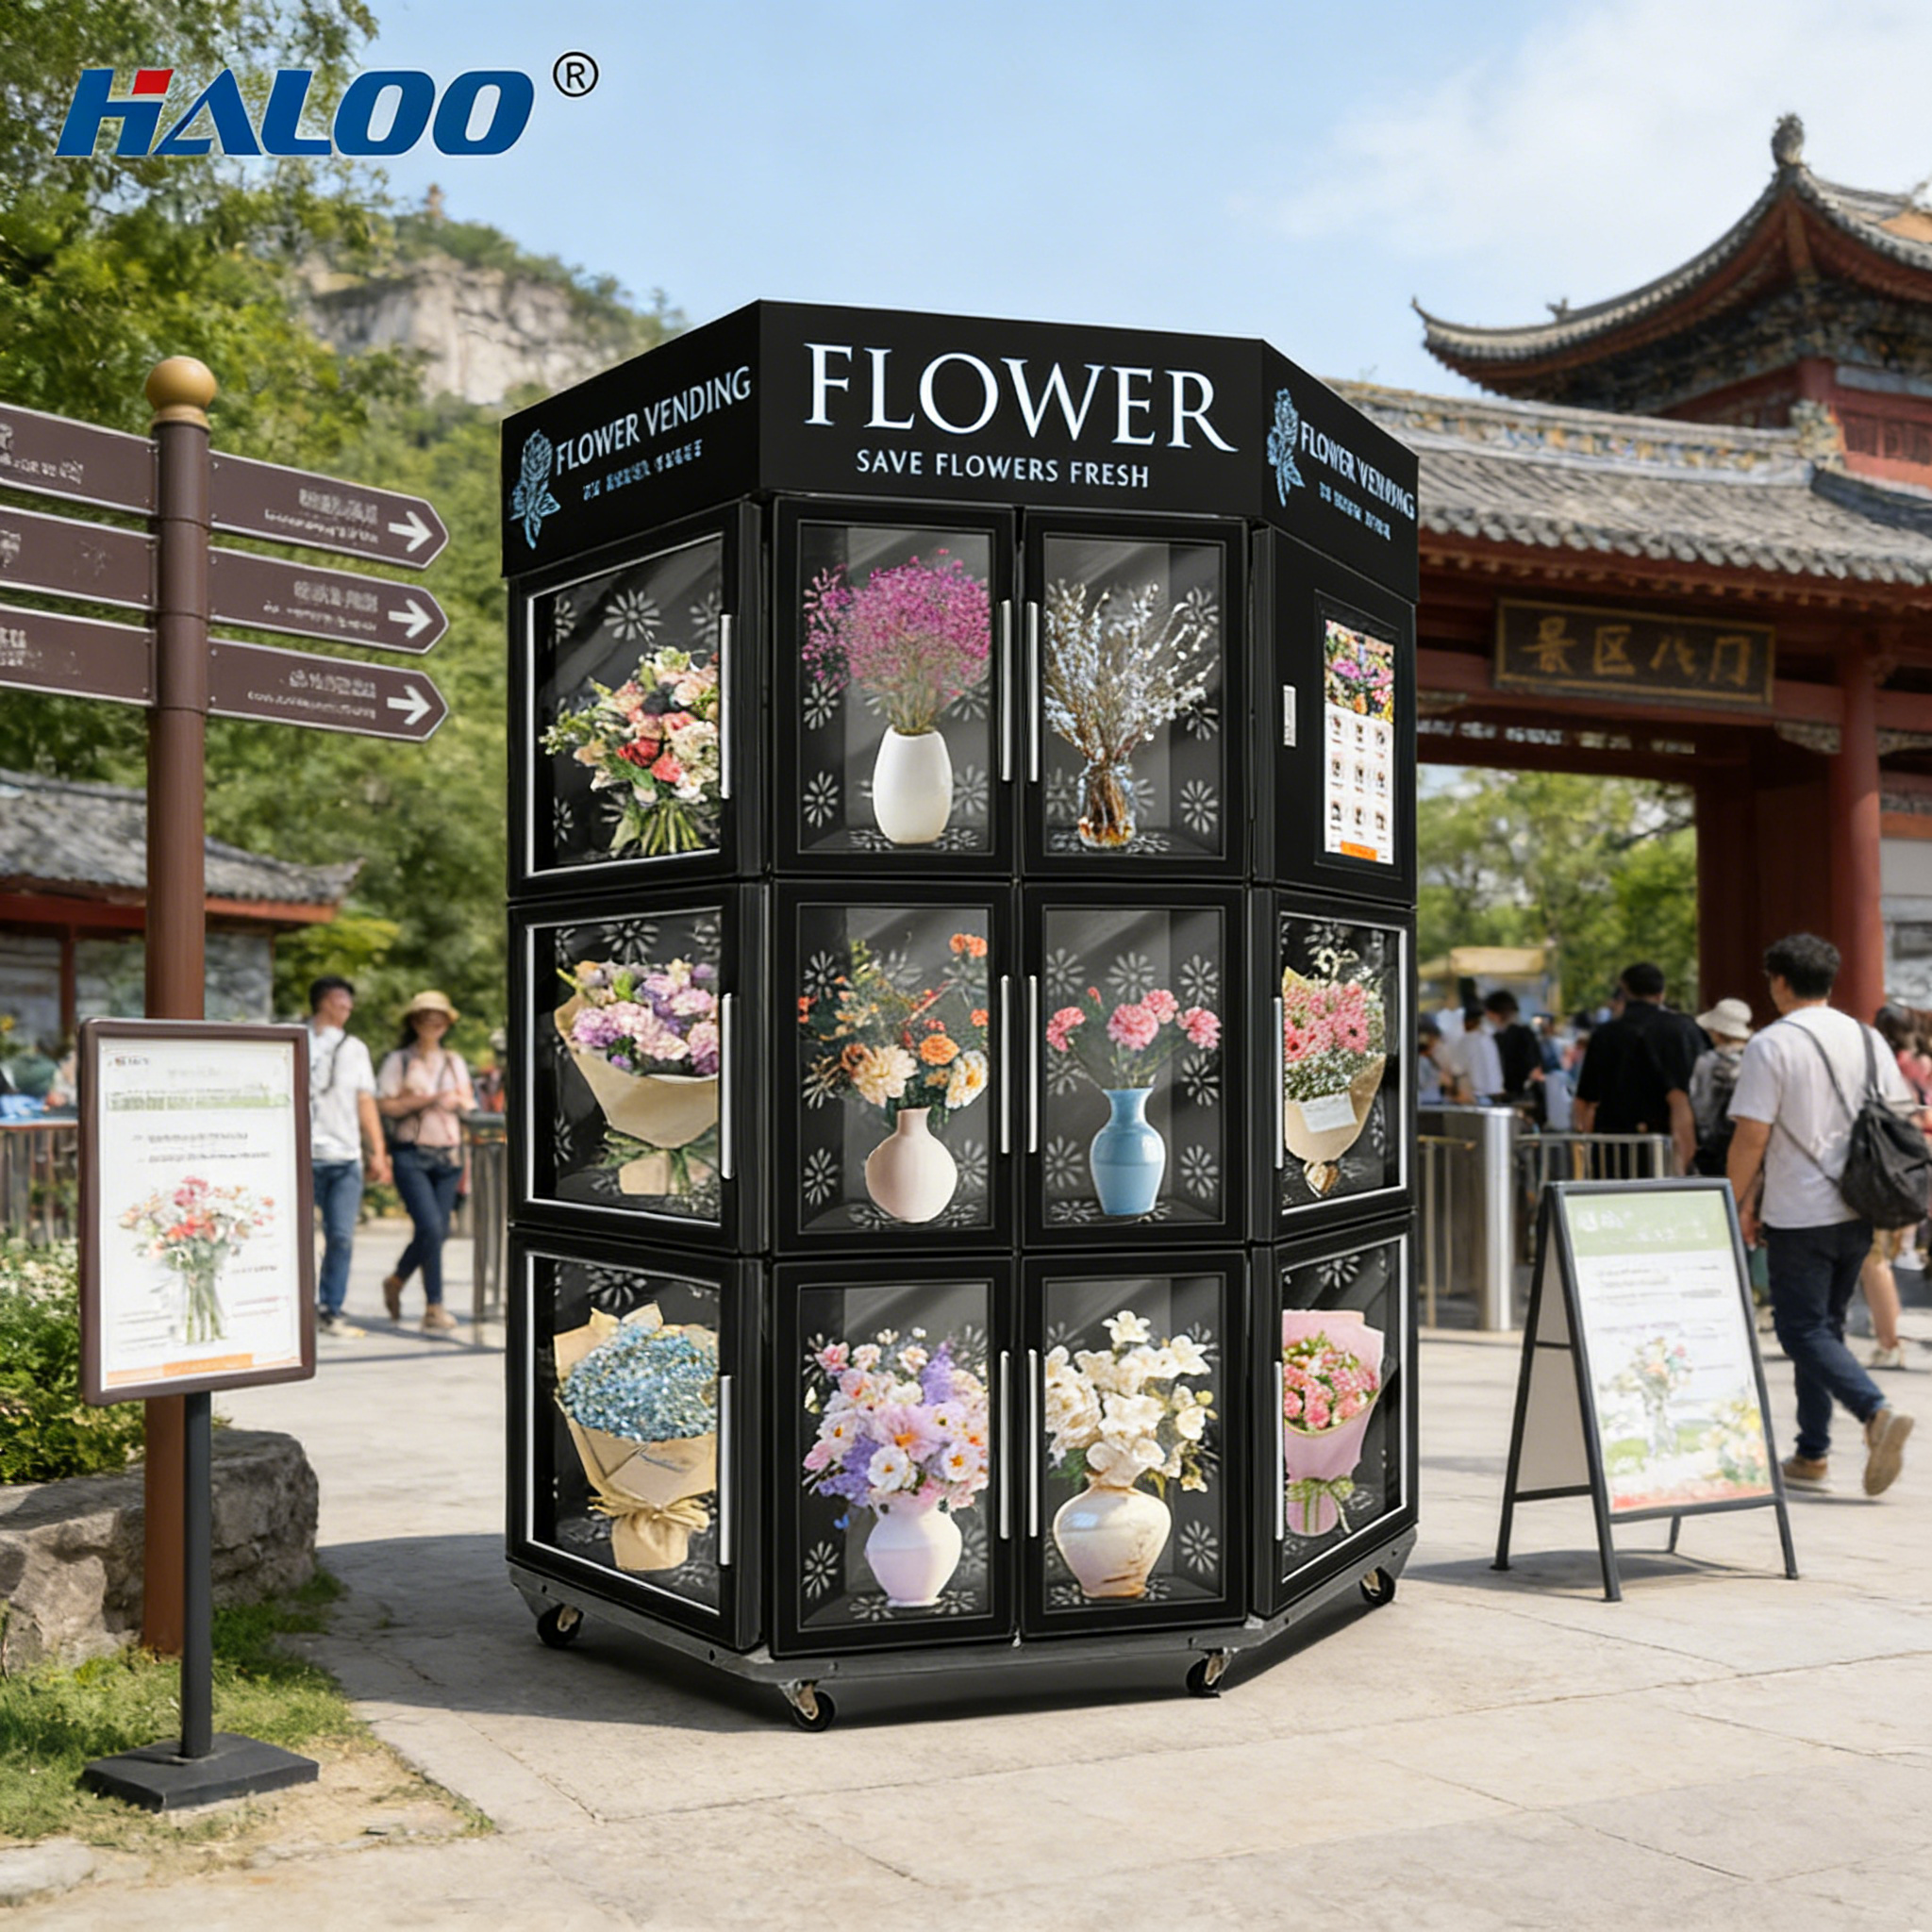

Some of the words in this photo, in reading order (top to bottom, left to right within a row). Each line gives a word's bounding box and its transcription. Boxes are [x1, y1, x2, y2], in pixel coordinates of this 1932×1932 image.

[556, 413, 641, 476] FLOWER
[644, 365, 751, 437] VENDING
[804, 342, 1240, 452] FLOWER
[857, 449, 924, 475] SAVE
[936, 452, 1058, 483] FLOWERS
[1070, 460, 1149, 489] FRESH
[1300, 420, 1357, 484] FLOWER
